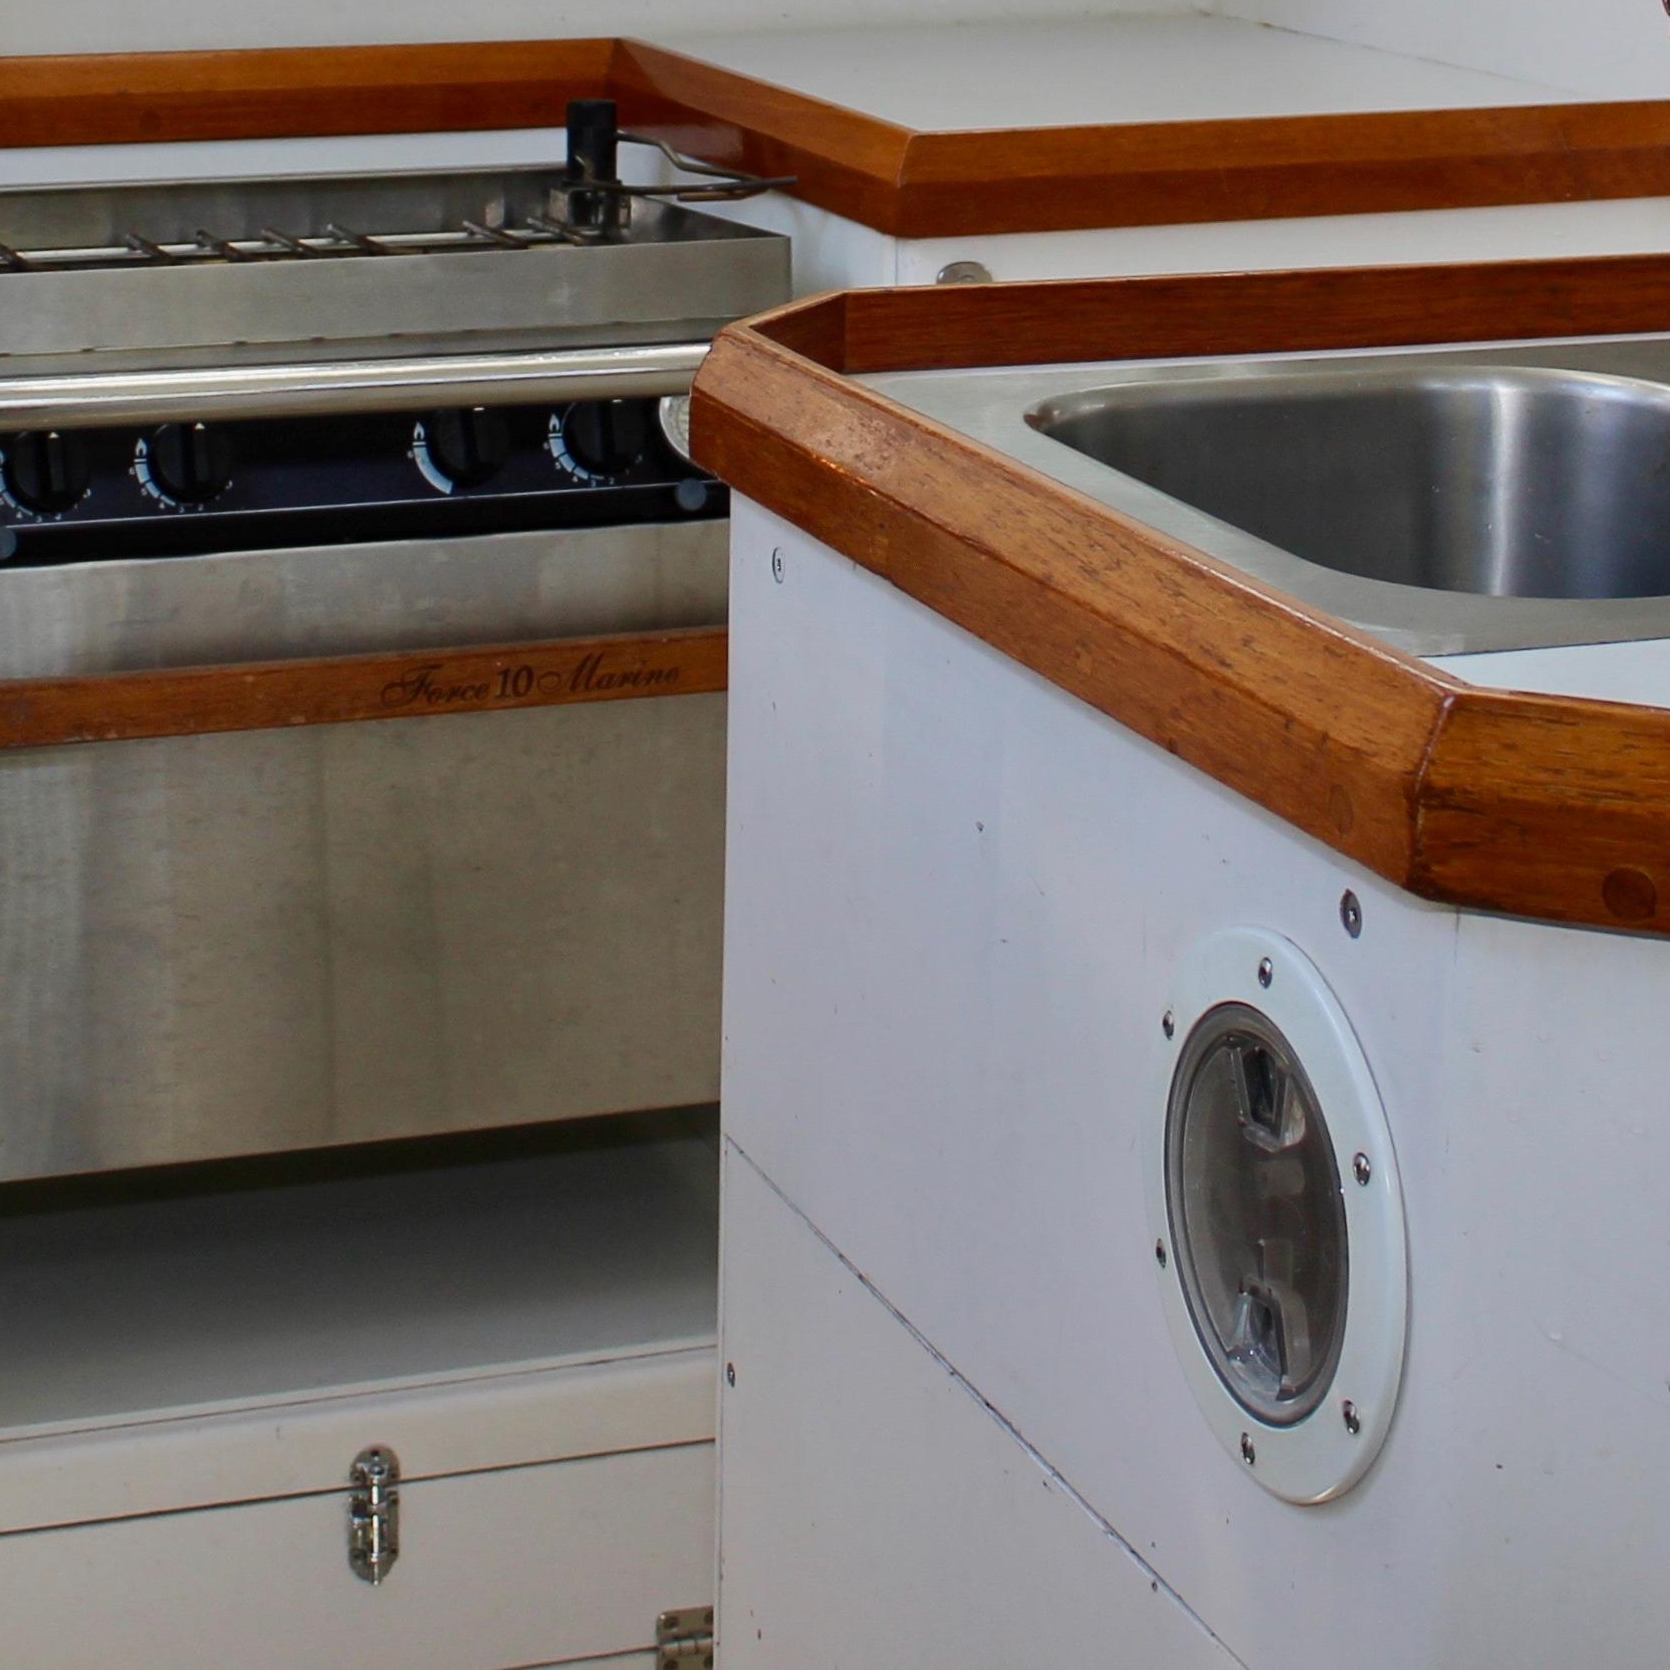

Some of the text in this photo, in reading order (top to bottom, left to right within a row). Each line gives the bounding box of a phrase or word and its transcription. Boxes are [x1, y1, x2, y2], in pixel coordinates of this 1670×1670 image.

[380, 652, 679, 708] Force 10 Marine
